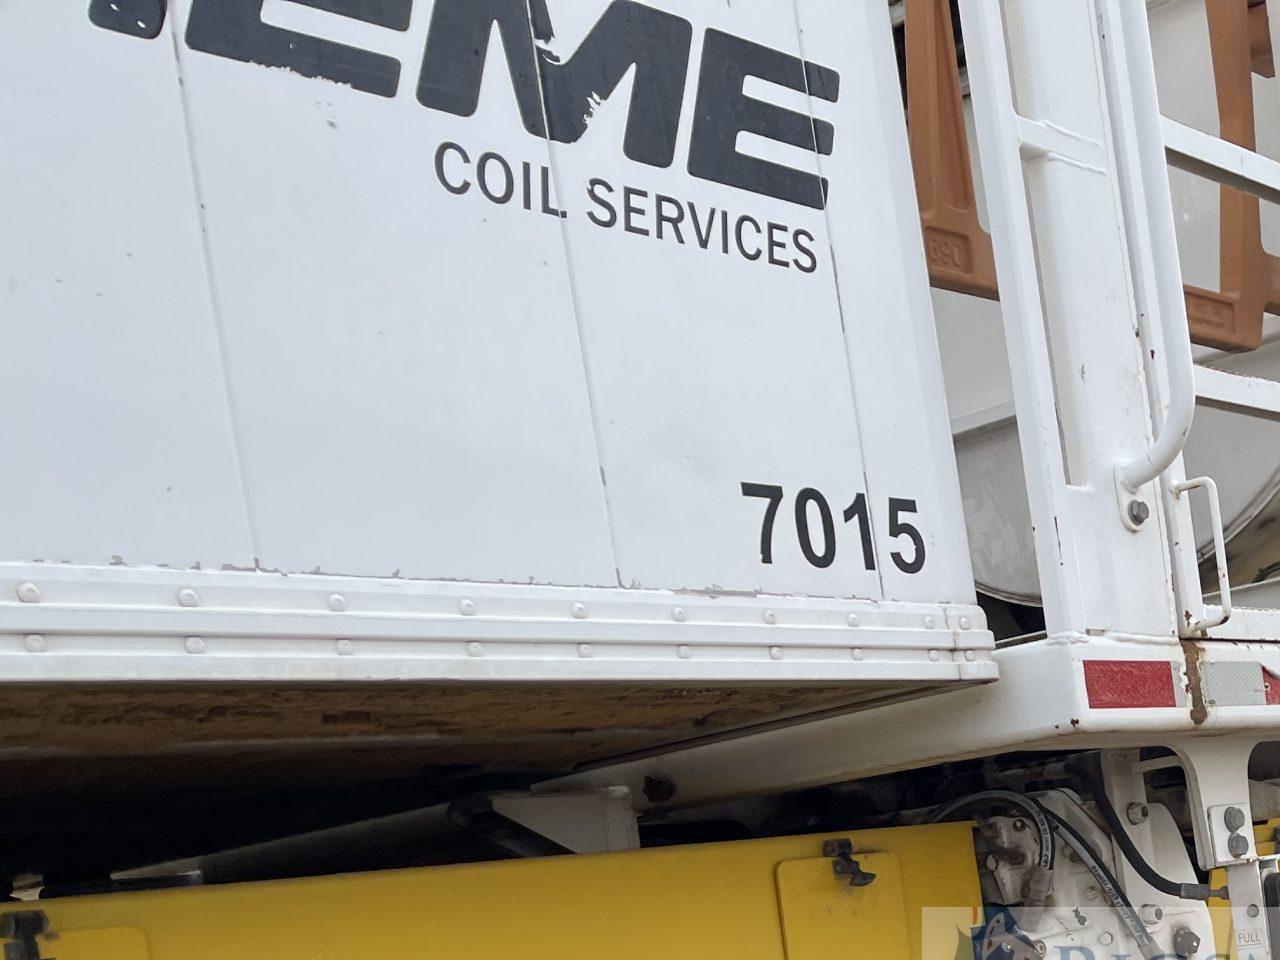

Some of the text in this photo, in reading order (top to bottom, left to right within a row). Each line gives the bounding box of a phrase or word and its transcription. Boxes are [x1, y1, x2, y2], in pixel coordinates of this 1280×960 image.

[434, 141, 817, 273] COIL SERVICES
[740, 481, 926, 575] 7015
[1237, 931, 1262, 944] FULL
